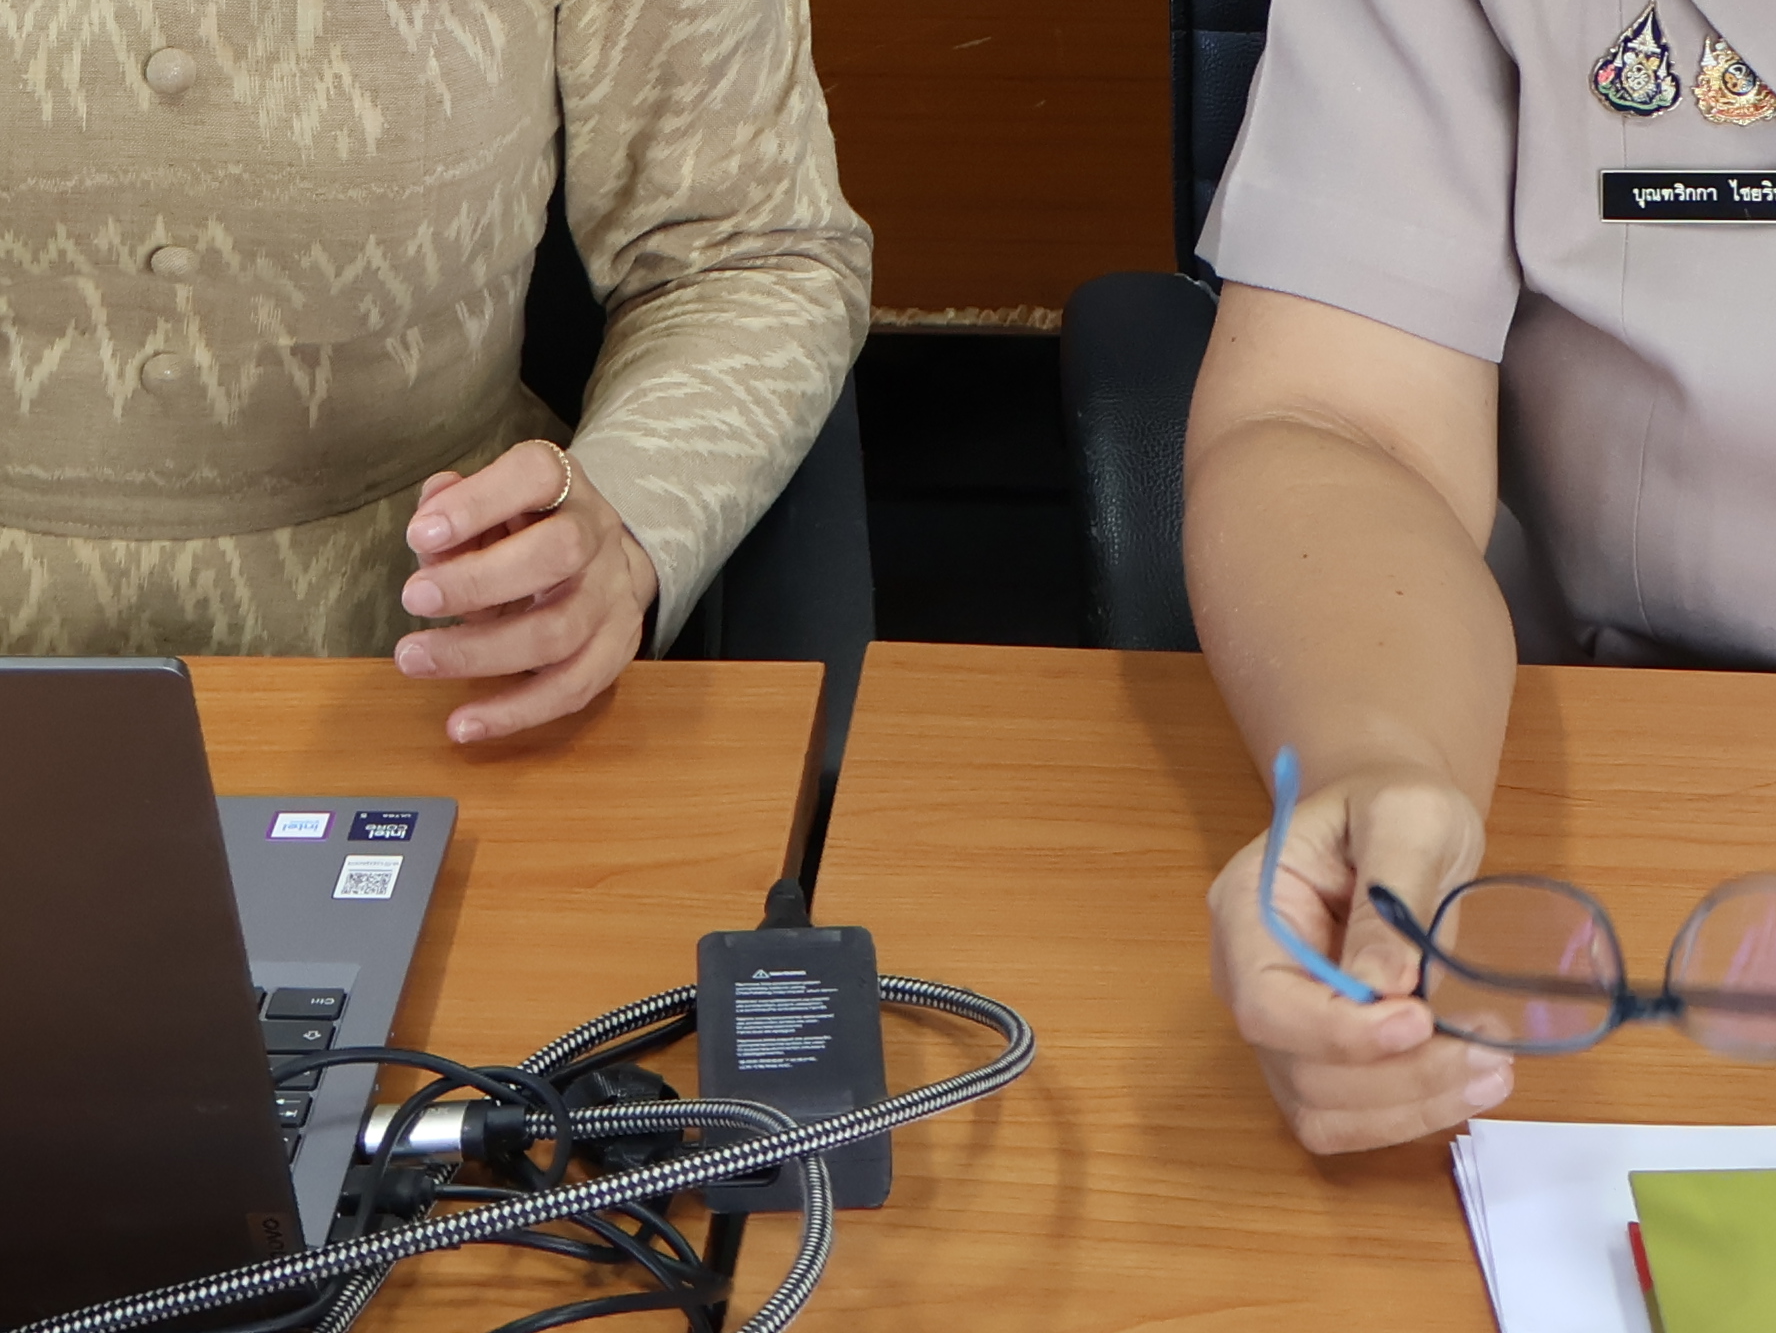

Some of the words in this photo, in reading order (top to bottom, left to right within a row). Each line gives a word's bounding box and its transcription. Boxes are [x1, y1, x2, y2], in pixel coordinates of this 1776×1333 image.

[282, 823, 320, 832] intel
[368, 830, 407, 839] intel
[310, 997, 335, 1006] Ctrl
